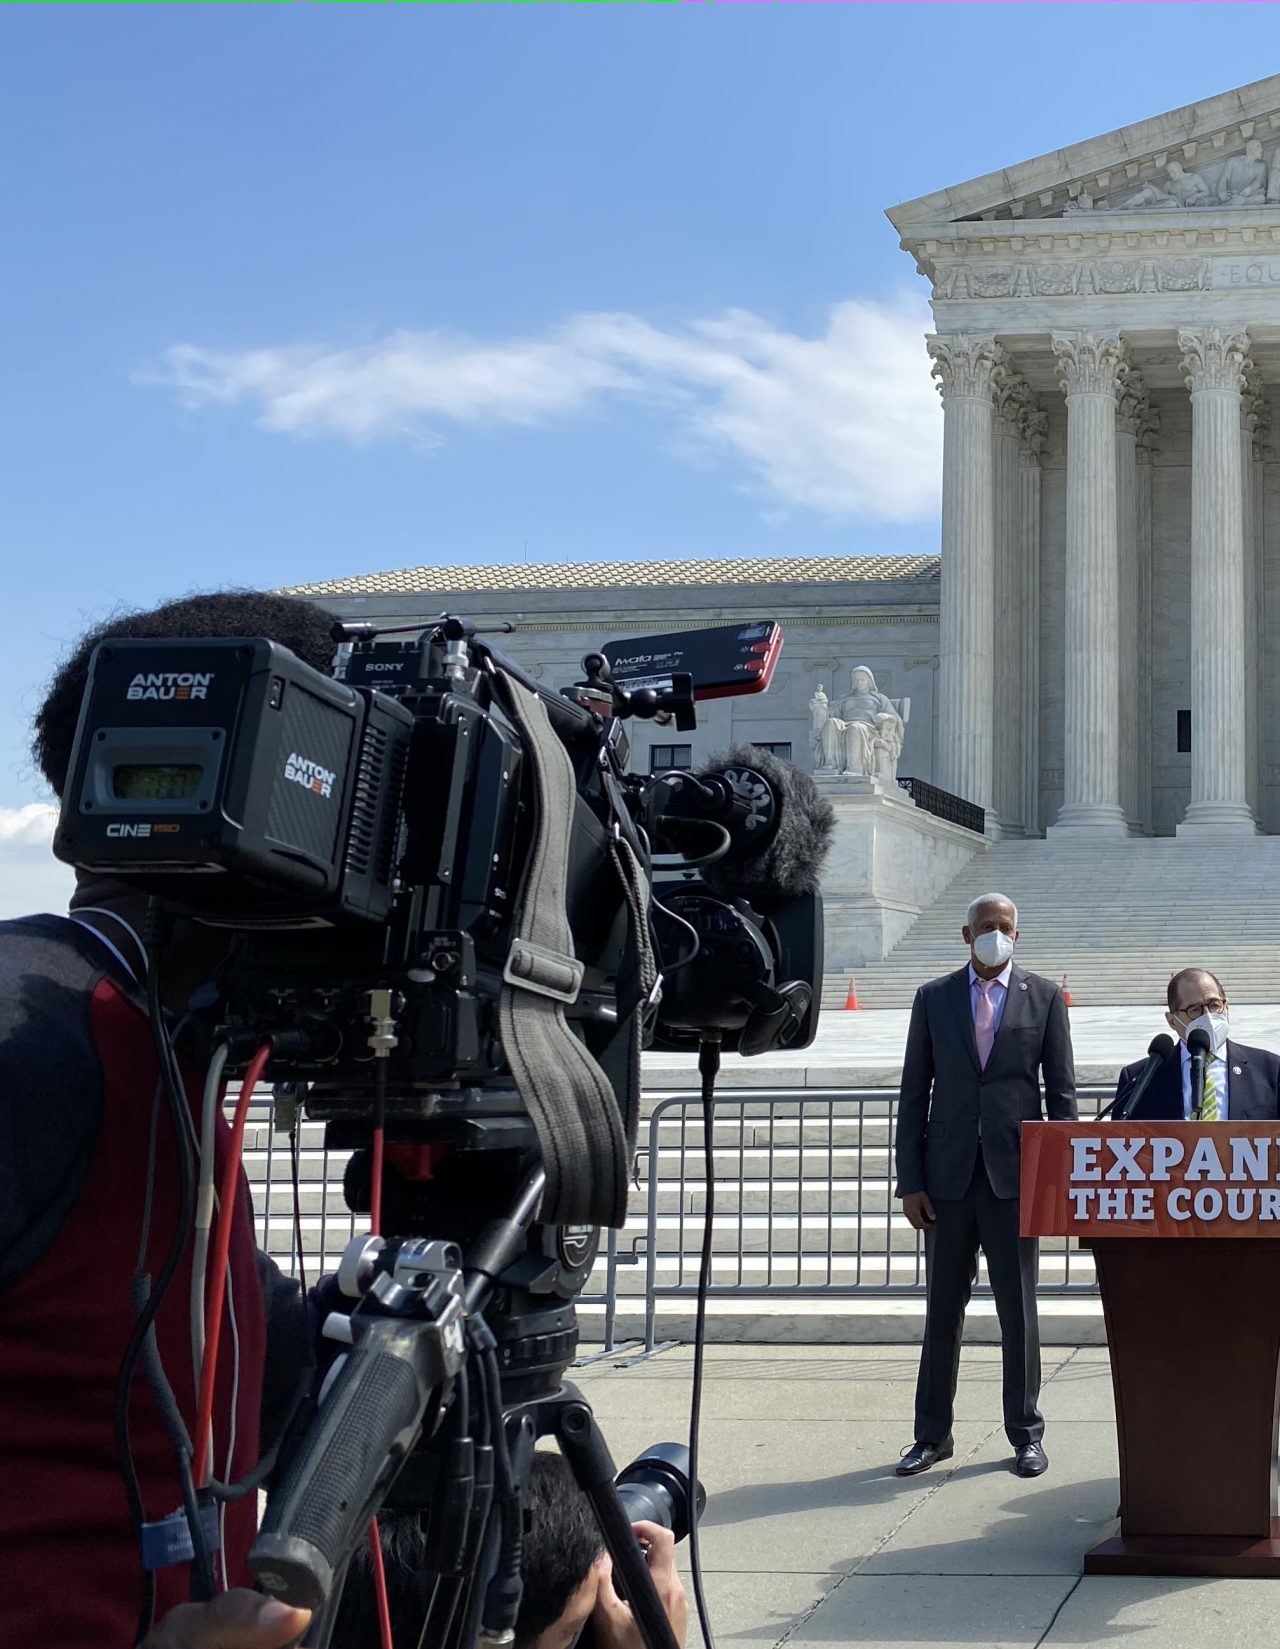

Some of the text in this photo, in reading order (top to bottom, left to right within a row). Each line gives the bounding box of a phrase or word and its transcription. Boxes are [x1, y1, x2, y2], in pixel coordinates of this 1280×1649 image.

[365, 663, 404, 672] SONY
[130, 673, 210, 687] ANTON
[126, 687, 207, 700] BAUER
[287, 752, 334, 785] ANTON
[284, 764, 331, 799] BAUER
[106, 823, 151, 837] CINE
[1068, 1188, 1155, 1221] THE
